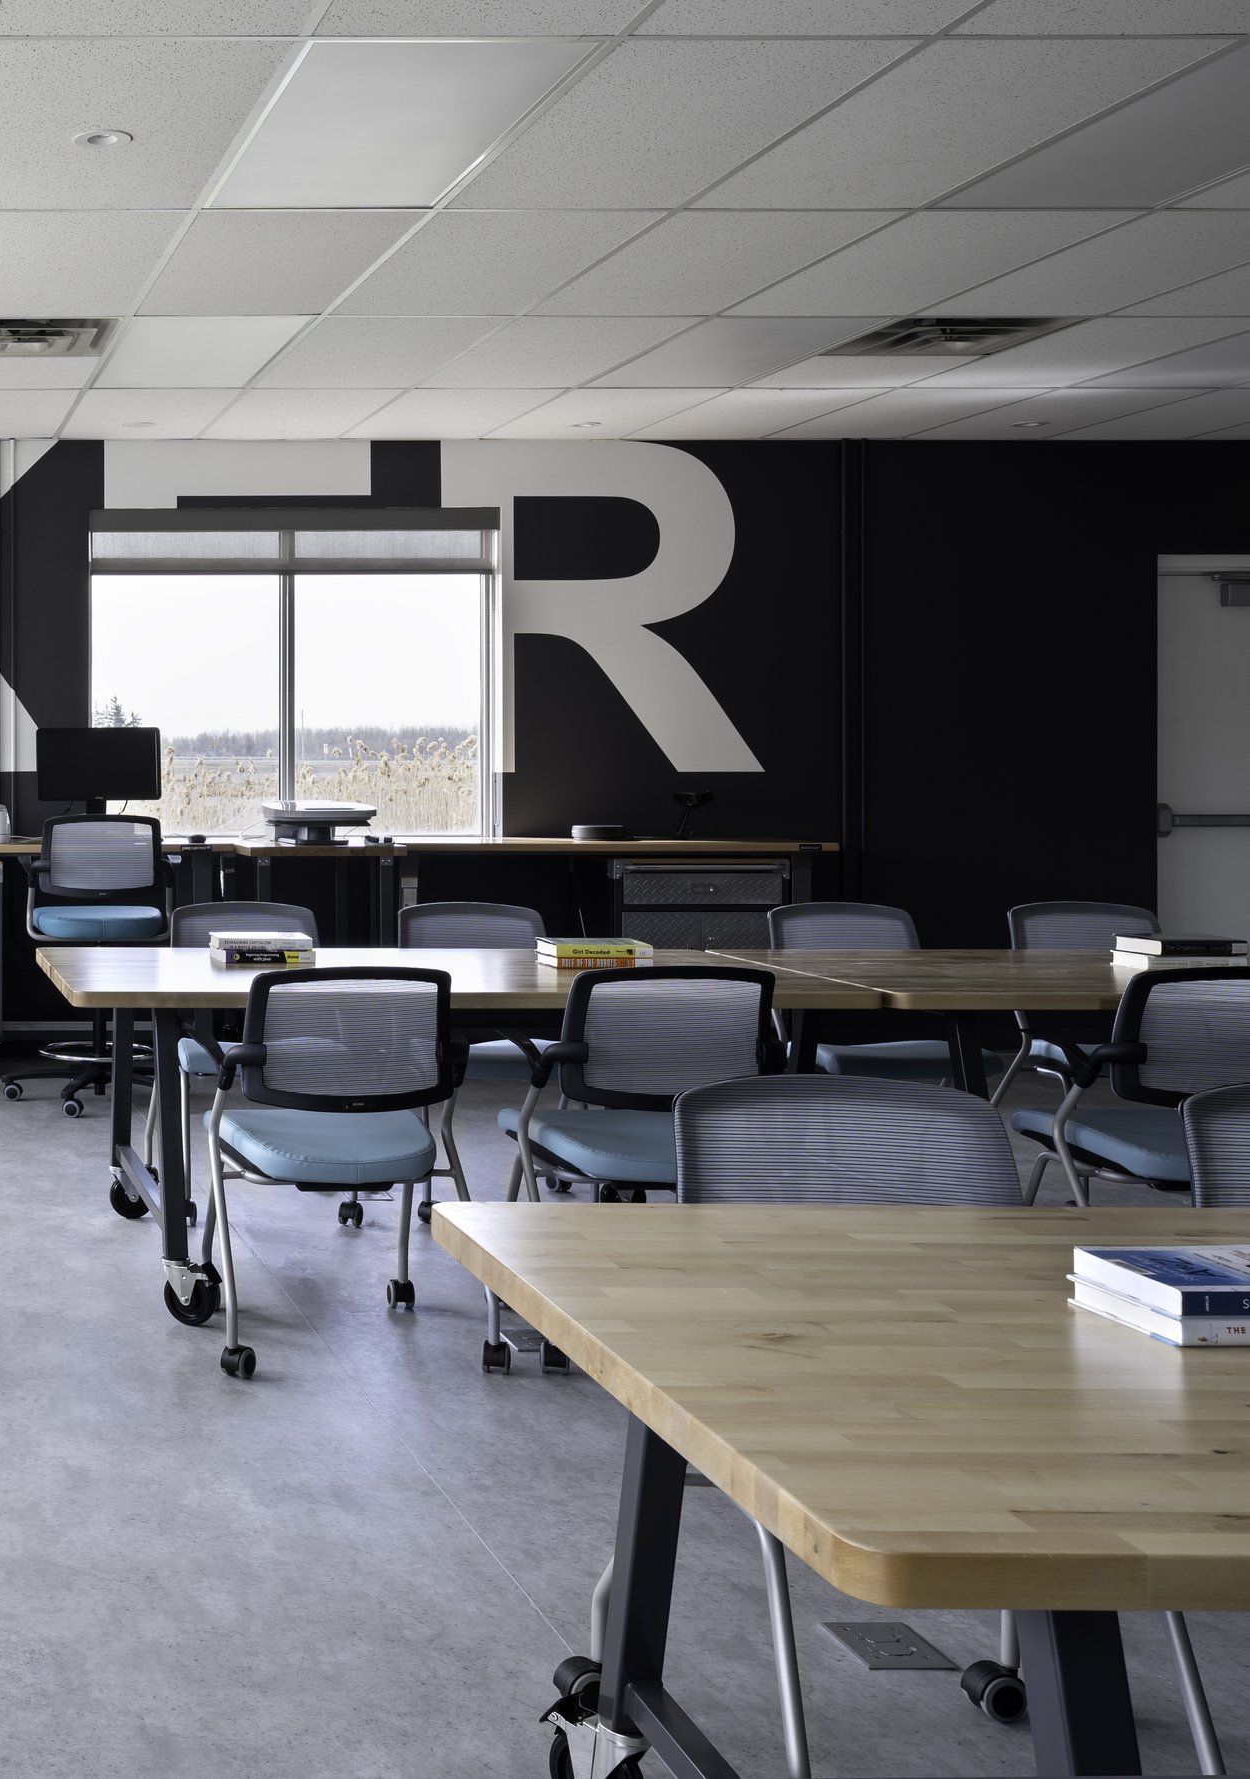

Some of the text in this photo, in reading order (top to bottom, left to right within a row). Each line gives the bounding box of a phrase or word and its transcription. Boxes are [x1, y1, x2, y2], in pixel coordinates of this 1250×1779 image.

[562, 959, 575, 967] RULE
[577, 959, 584, 967] OF
[585, 959, 595, 967] THE
[596, 959, 617, 967] ROBOTS
[1242, 1298, 1250, 1310] S
[1226, 1326, 1247, 1334] THE
